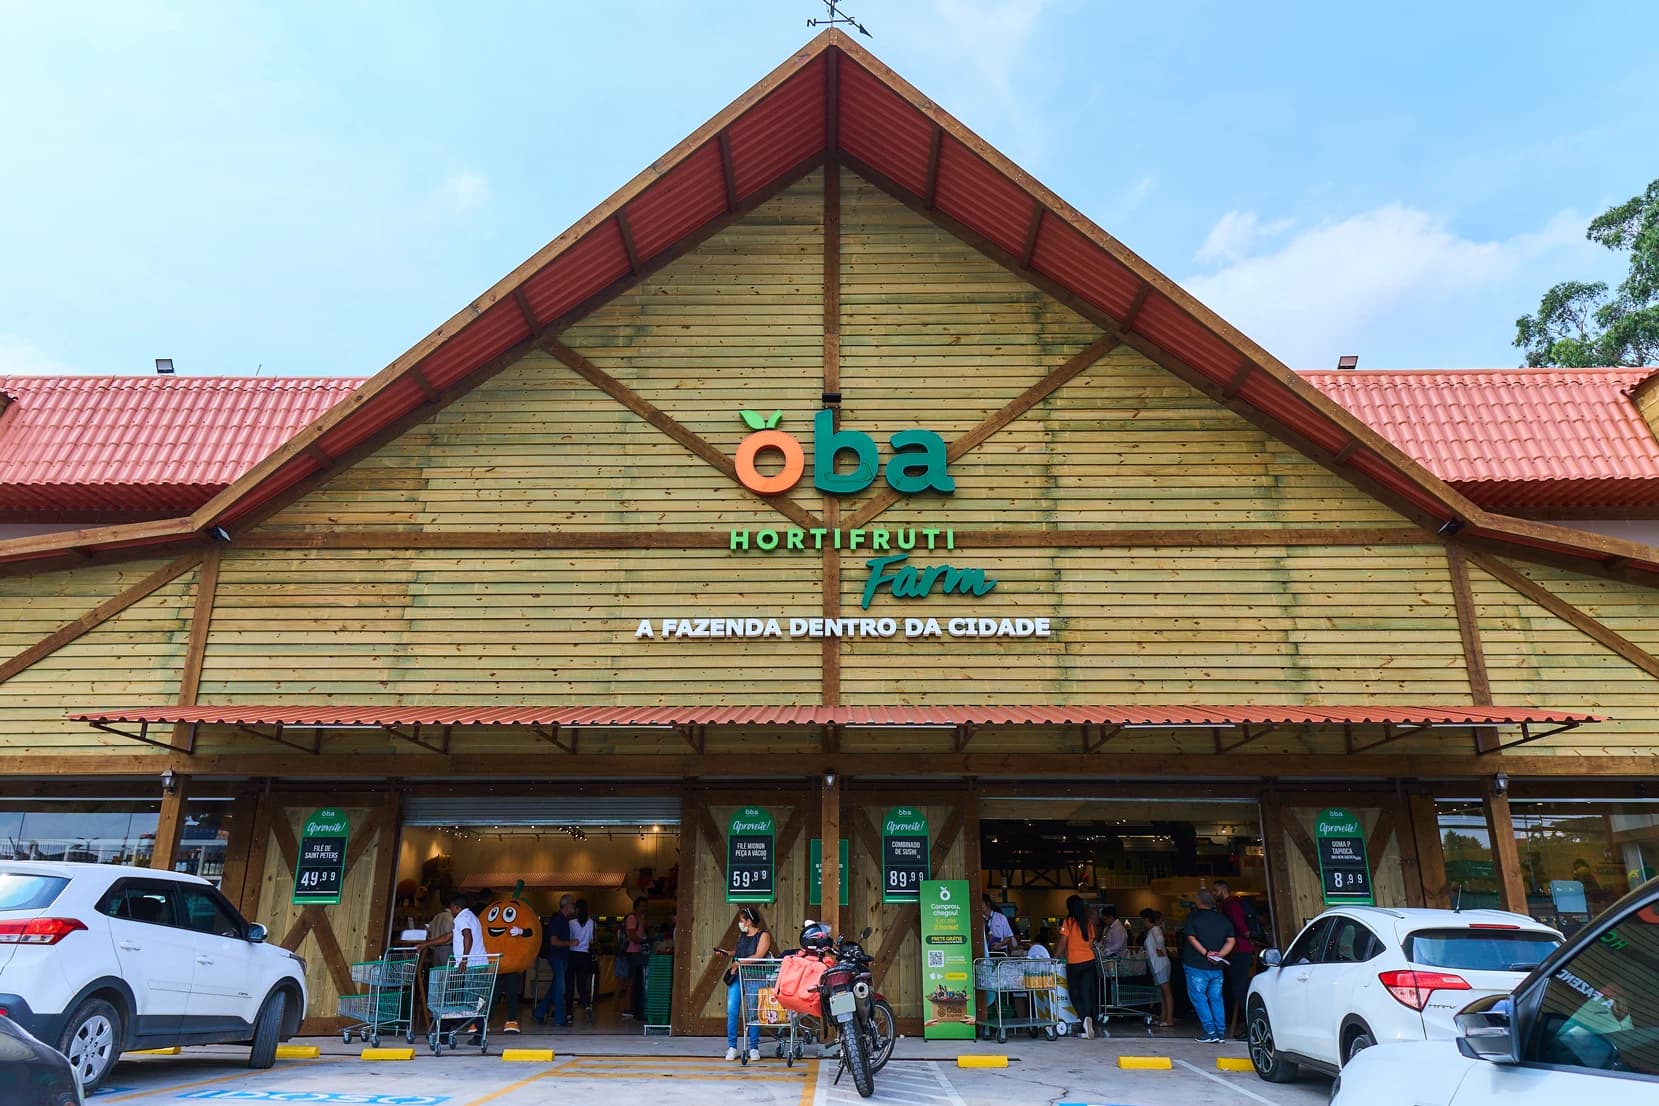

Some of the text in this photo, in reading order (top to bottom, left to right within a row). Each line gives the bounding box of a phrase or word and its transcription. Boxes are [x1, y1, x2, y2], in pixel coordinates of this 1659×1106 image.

[806, 18, 816, 27] N
[729, 528, 955, 551] HORTIFRUTI
[861, 553, 998, 609] Farm
[635, 618, 1051, 638] A FAZENDA DENTRO DA CIDADE
[313, 844, 332, 852] FILÉ DE
[304, 851, 338, 859] SAINT PETERS
[735, 849, 747, 858] PEÇA
